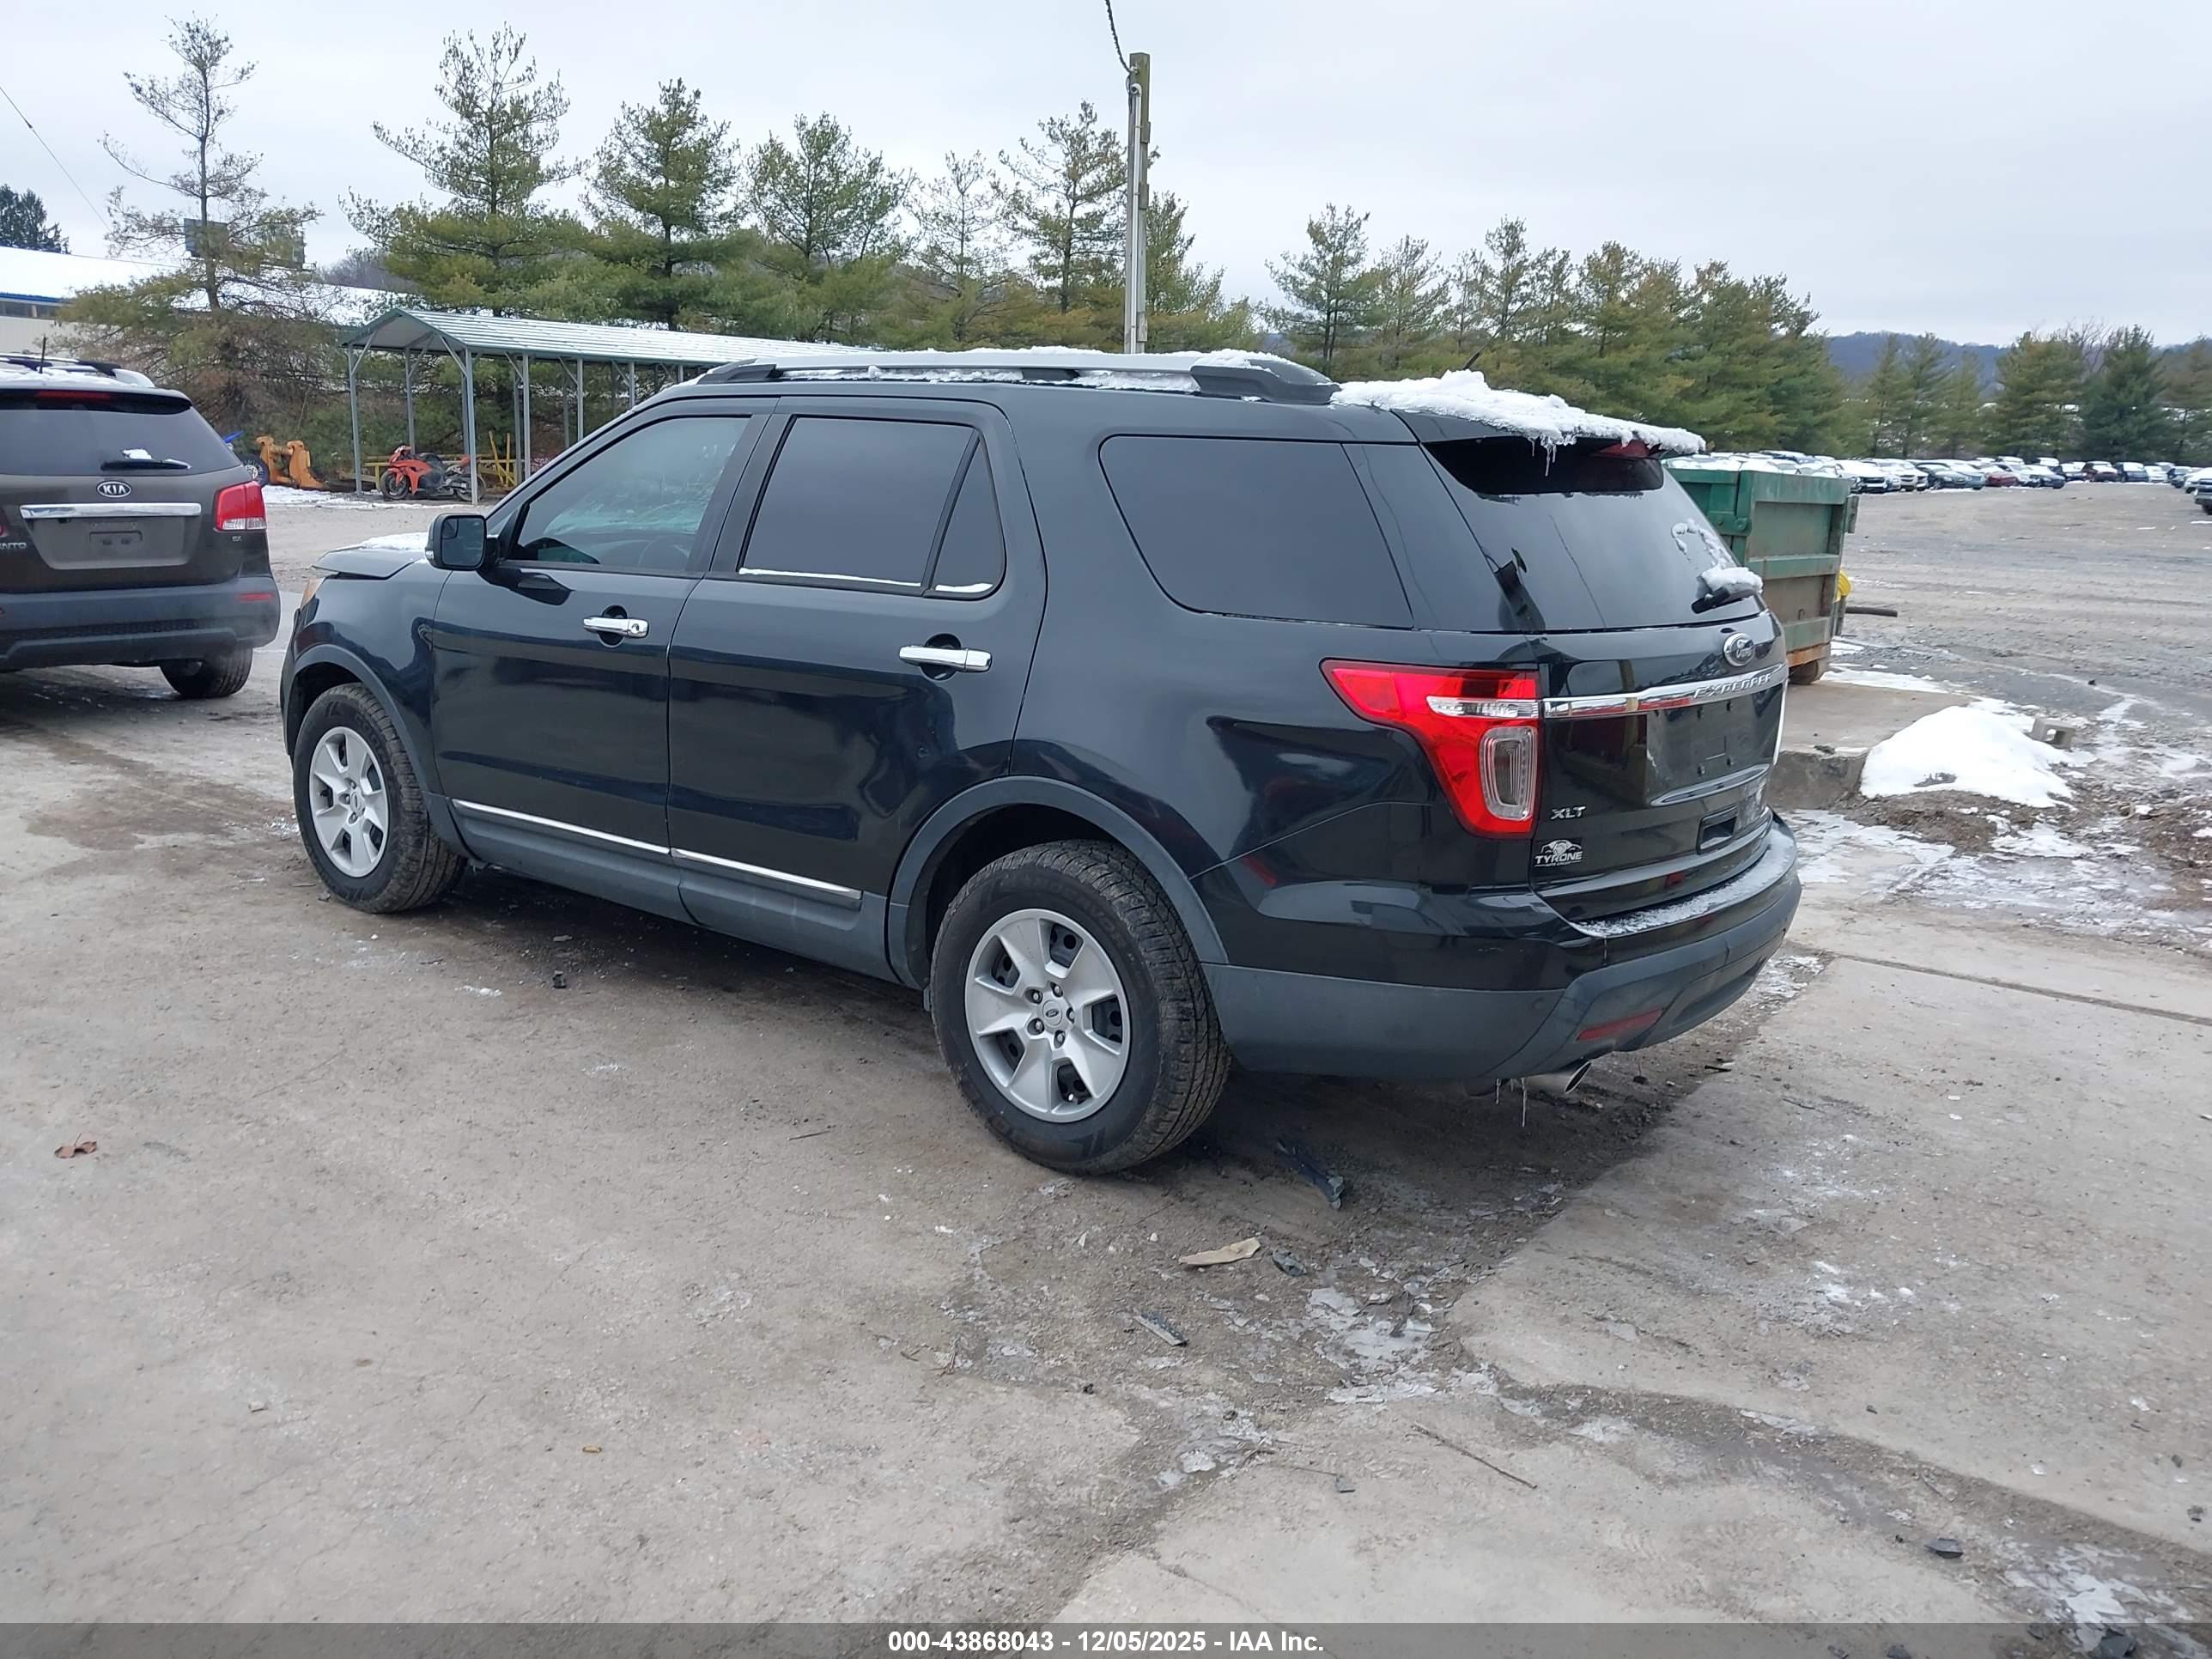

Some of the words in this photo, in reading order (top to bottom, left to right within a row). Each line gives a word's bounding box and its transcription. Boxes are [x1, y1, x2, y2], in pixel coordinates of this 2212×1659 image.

[102, 484, 127, 495] KIA
[1550, 805, 1586, 820] XLT
[1534, 851, 1583, 864] TYRONE
